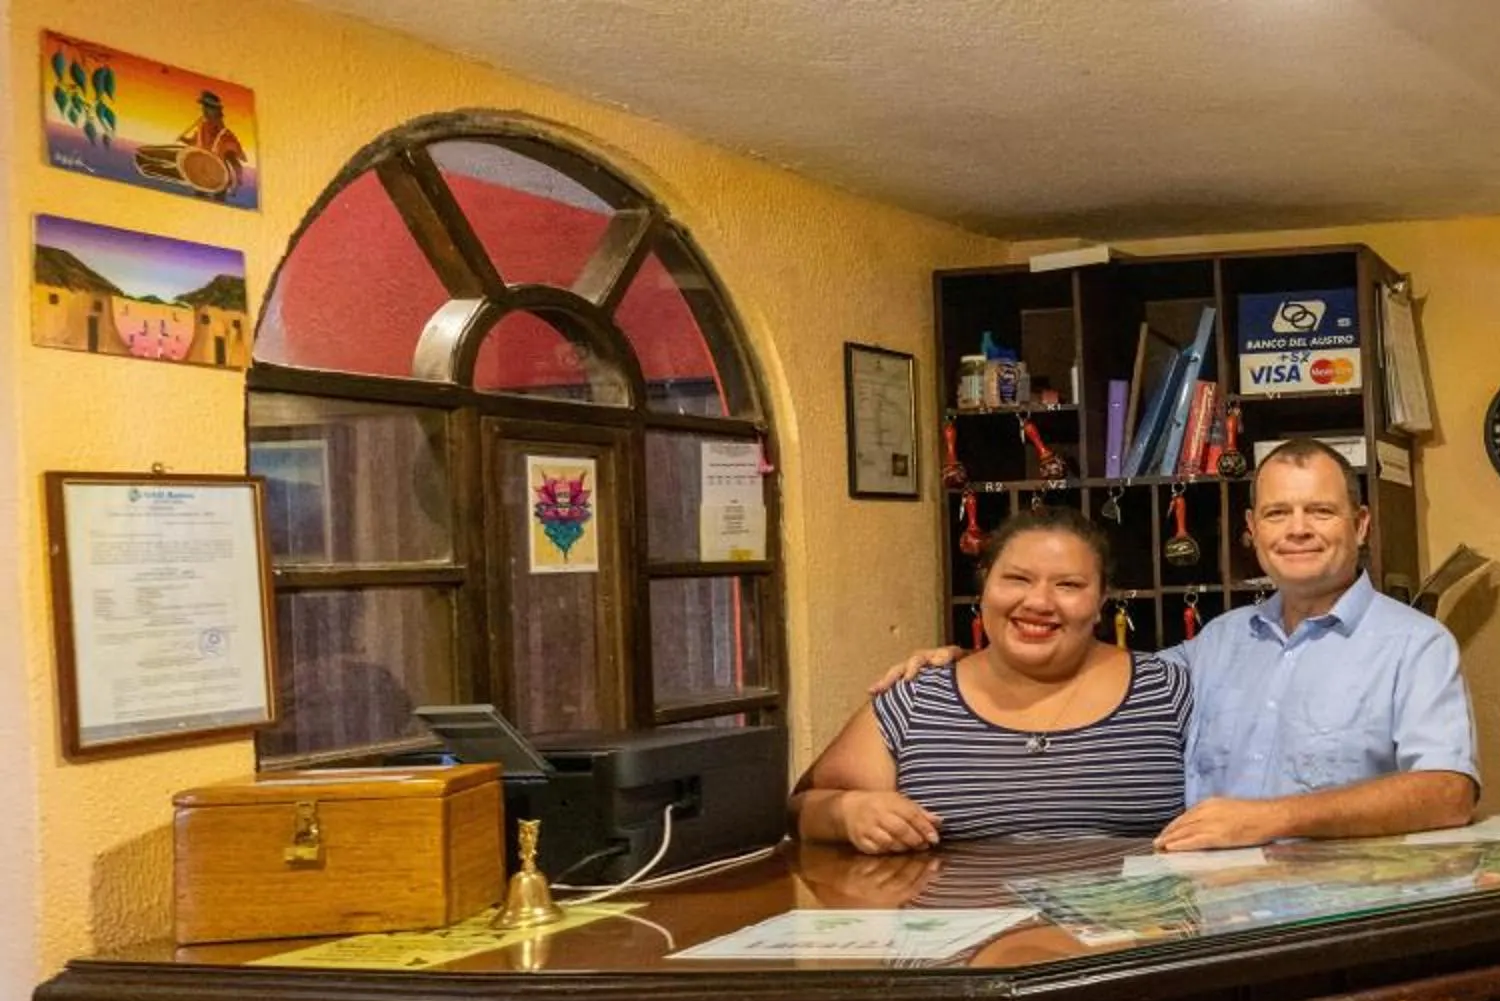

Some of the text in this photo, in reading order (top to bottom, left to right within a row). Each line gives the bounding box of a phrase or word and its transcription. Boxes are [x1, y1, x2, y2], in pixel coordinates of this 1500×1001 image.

[1247, 335, 1354, 349] BANCO DEL AUSTRO
[1249, 364, 1301, 384] VISA
